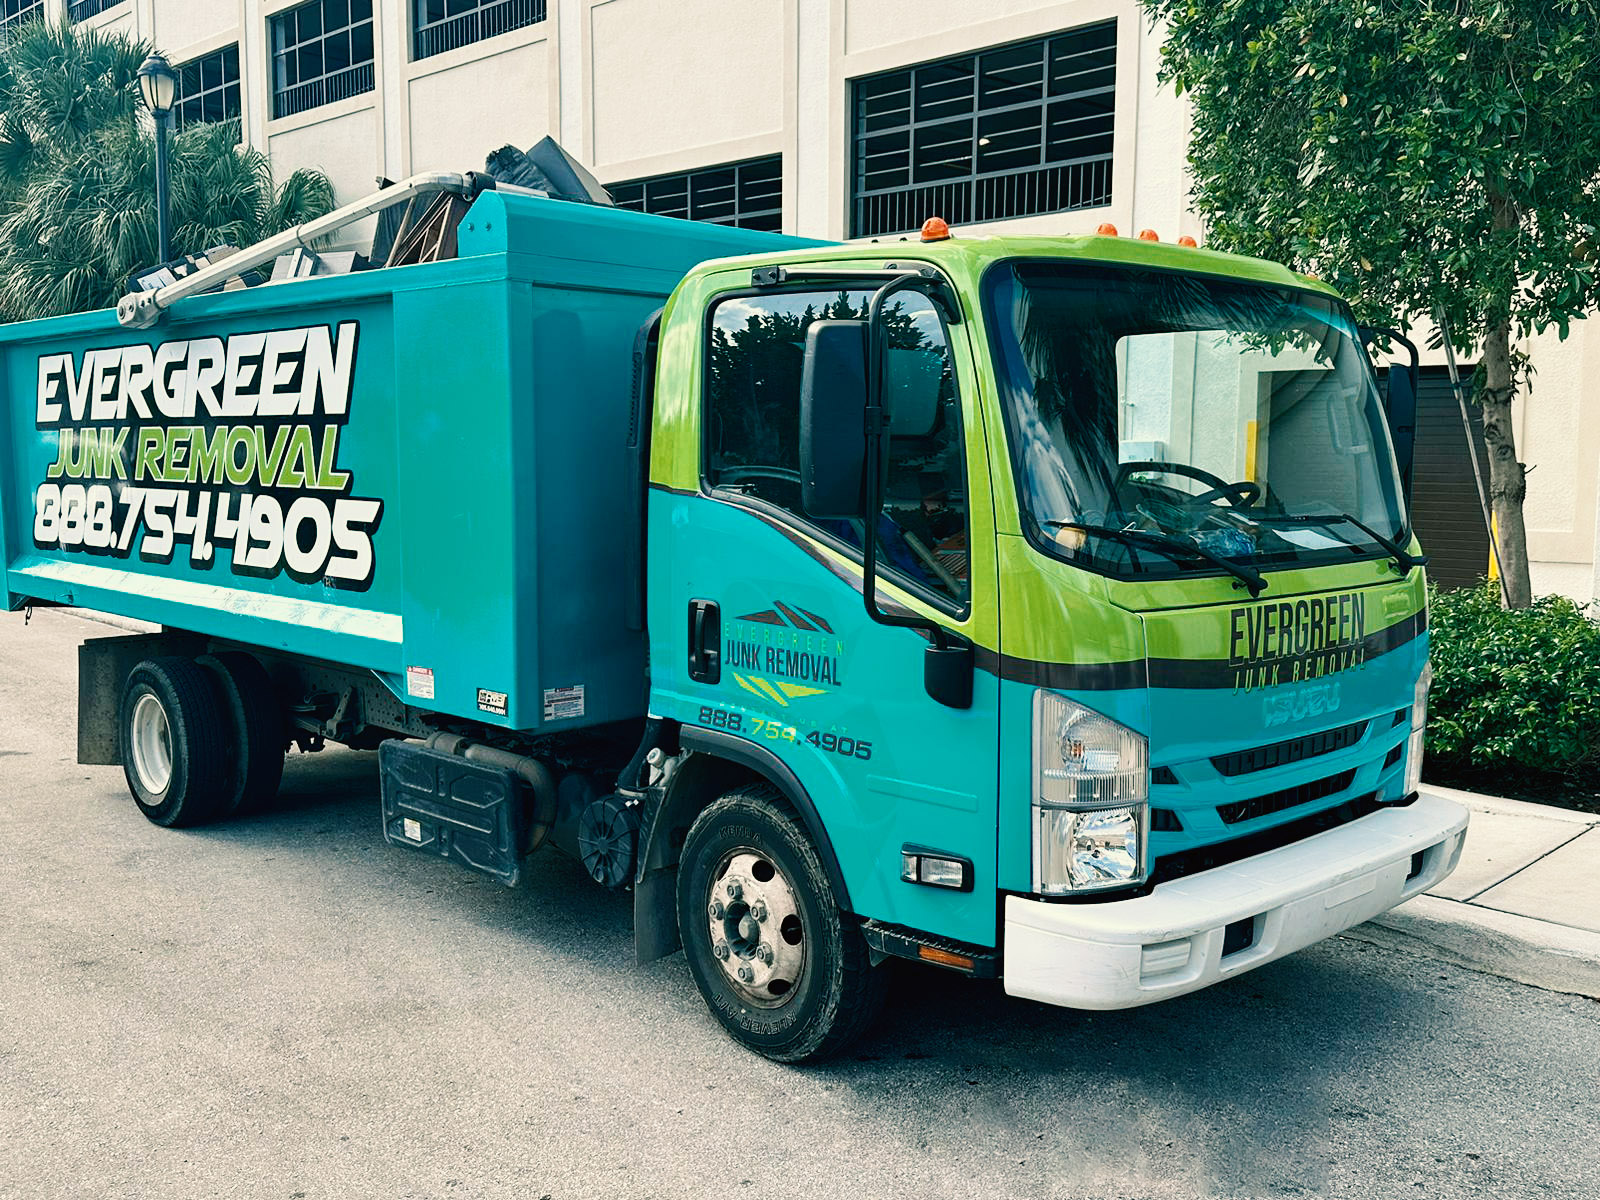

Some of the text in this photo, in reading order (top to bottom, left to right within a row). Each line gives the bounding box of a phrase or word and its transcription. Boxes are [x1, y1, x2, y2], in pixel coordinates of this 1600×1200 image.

[36, 322, 358, 422] EVERGREEN
[47, 424, 351, 491] JUNK REMOVAL
[34, 484, 381, 581] 888.754.4905
[724, 622, 844, 657] EVERGREEN
[1229, 592, 1365, 667] EVERGREEN
[725, 639, 842, 686] JUNK REMOVAL
[1233, 648, 1366, 696] JUNK REMOVAL
[698, 706, 873, 761] 888.754.4905
